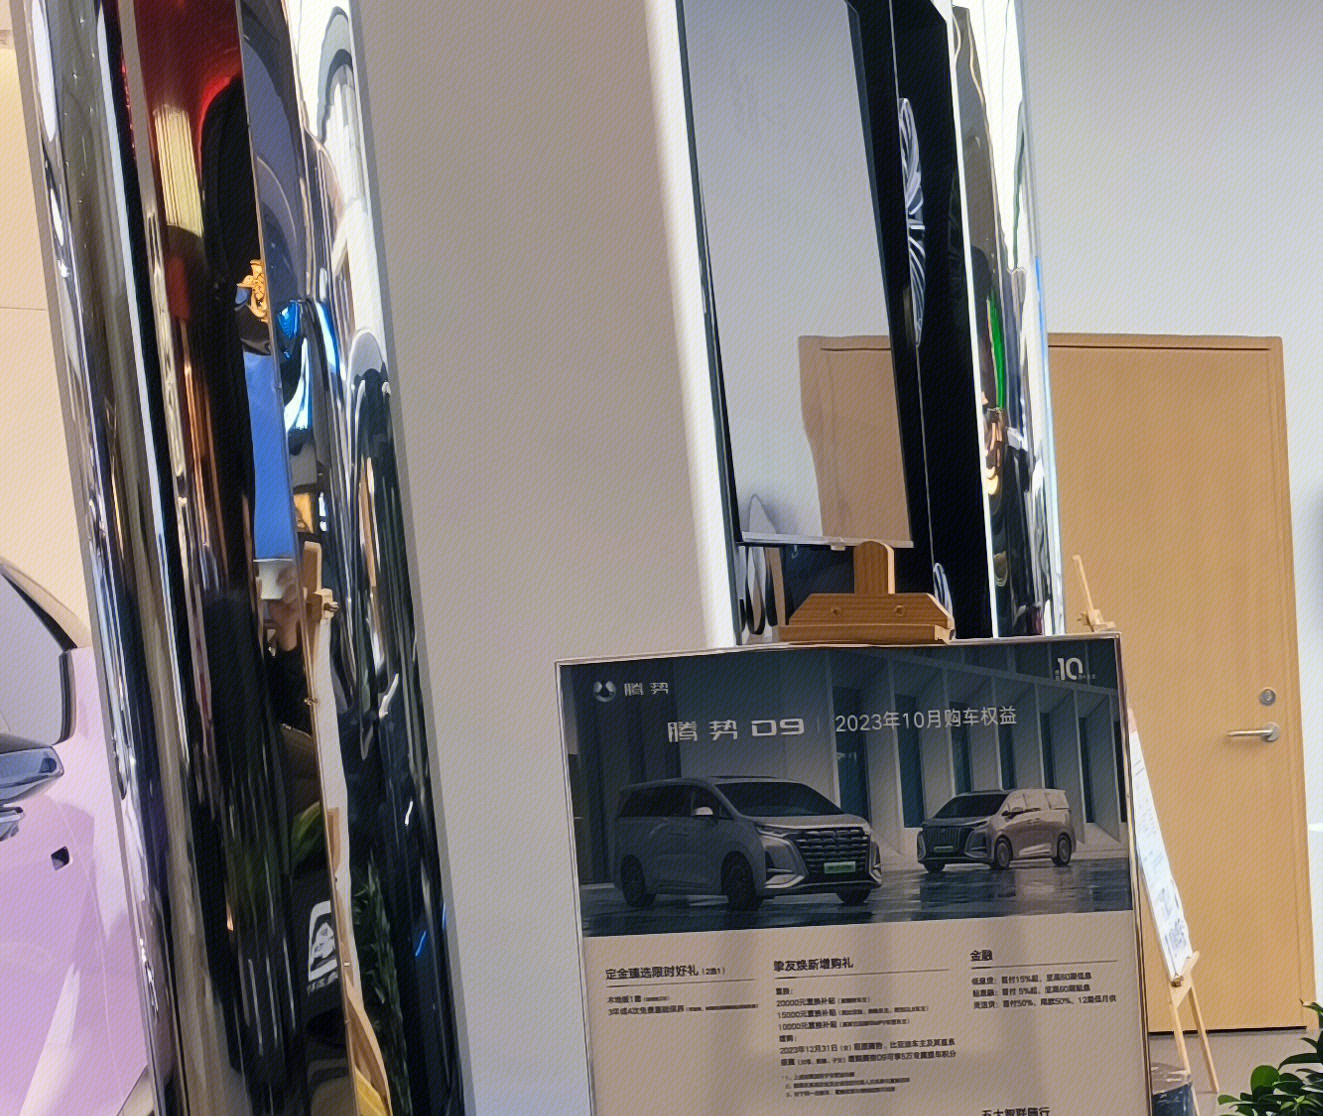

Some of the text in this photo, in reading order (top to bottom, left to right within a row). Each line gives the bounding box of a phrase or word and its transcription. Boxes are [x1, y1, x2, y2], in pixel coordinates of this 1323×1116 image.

[835, 705, 1017, 733] 2023年10月购车权益
